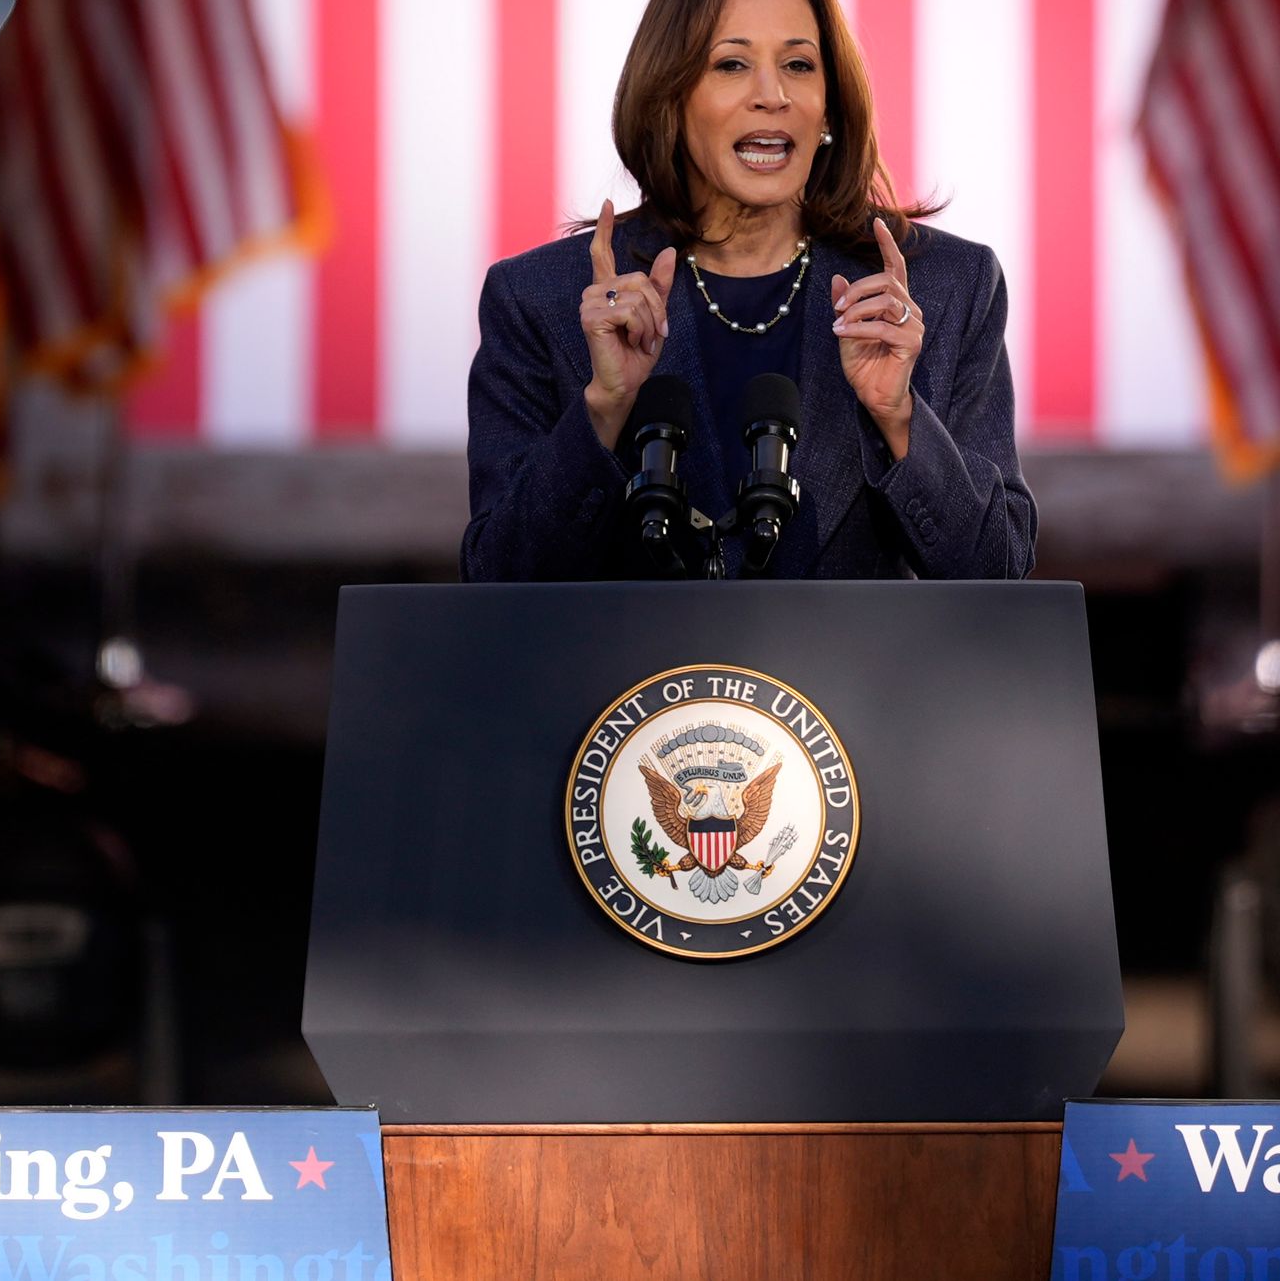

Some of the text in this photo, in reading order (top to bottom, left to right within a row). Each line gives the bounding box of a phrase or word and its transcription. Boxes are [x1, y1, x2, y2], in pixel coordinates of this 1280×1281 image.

[682, 768, 719, 778] PLURIBUS
[722, 771, 746, 780] UNUM
[572, 677, 851, 941] VICE PRESIDENT OF THE UNITED STATES
[156, 1131, 273, 1200] PA
